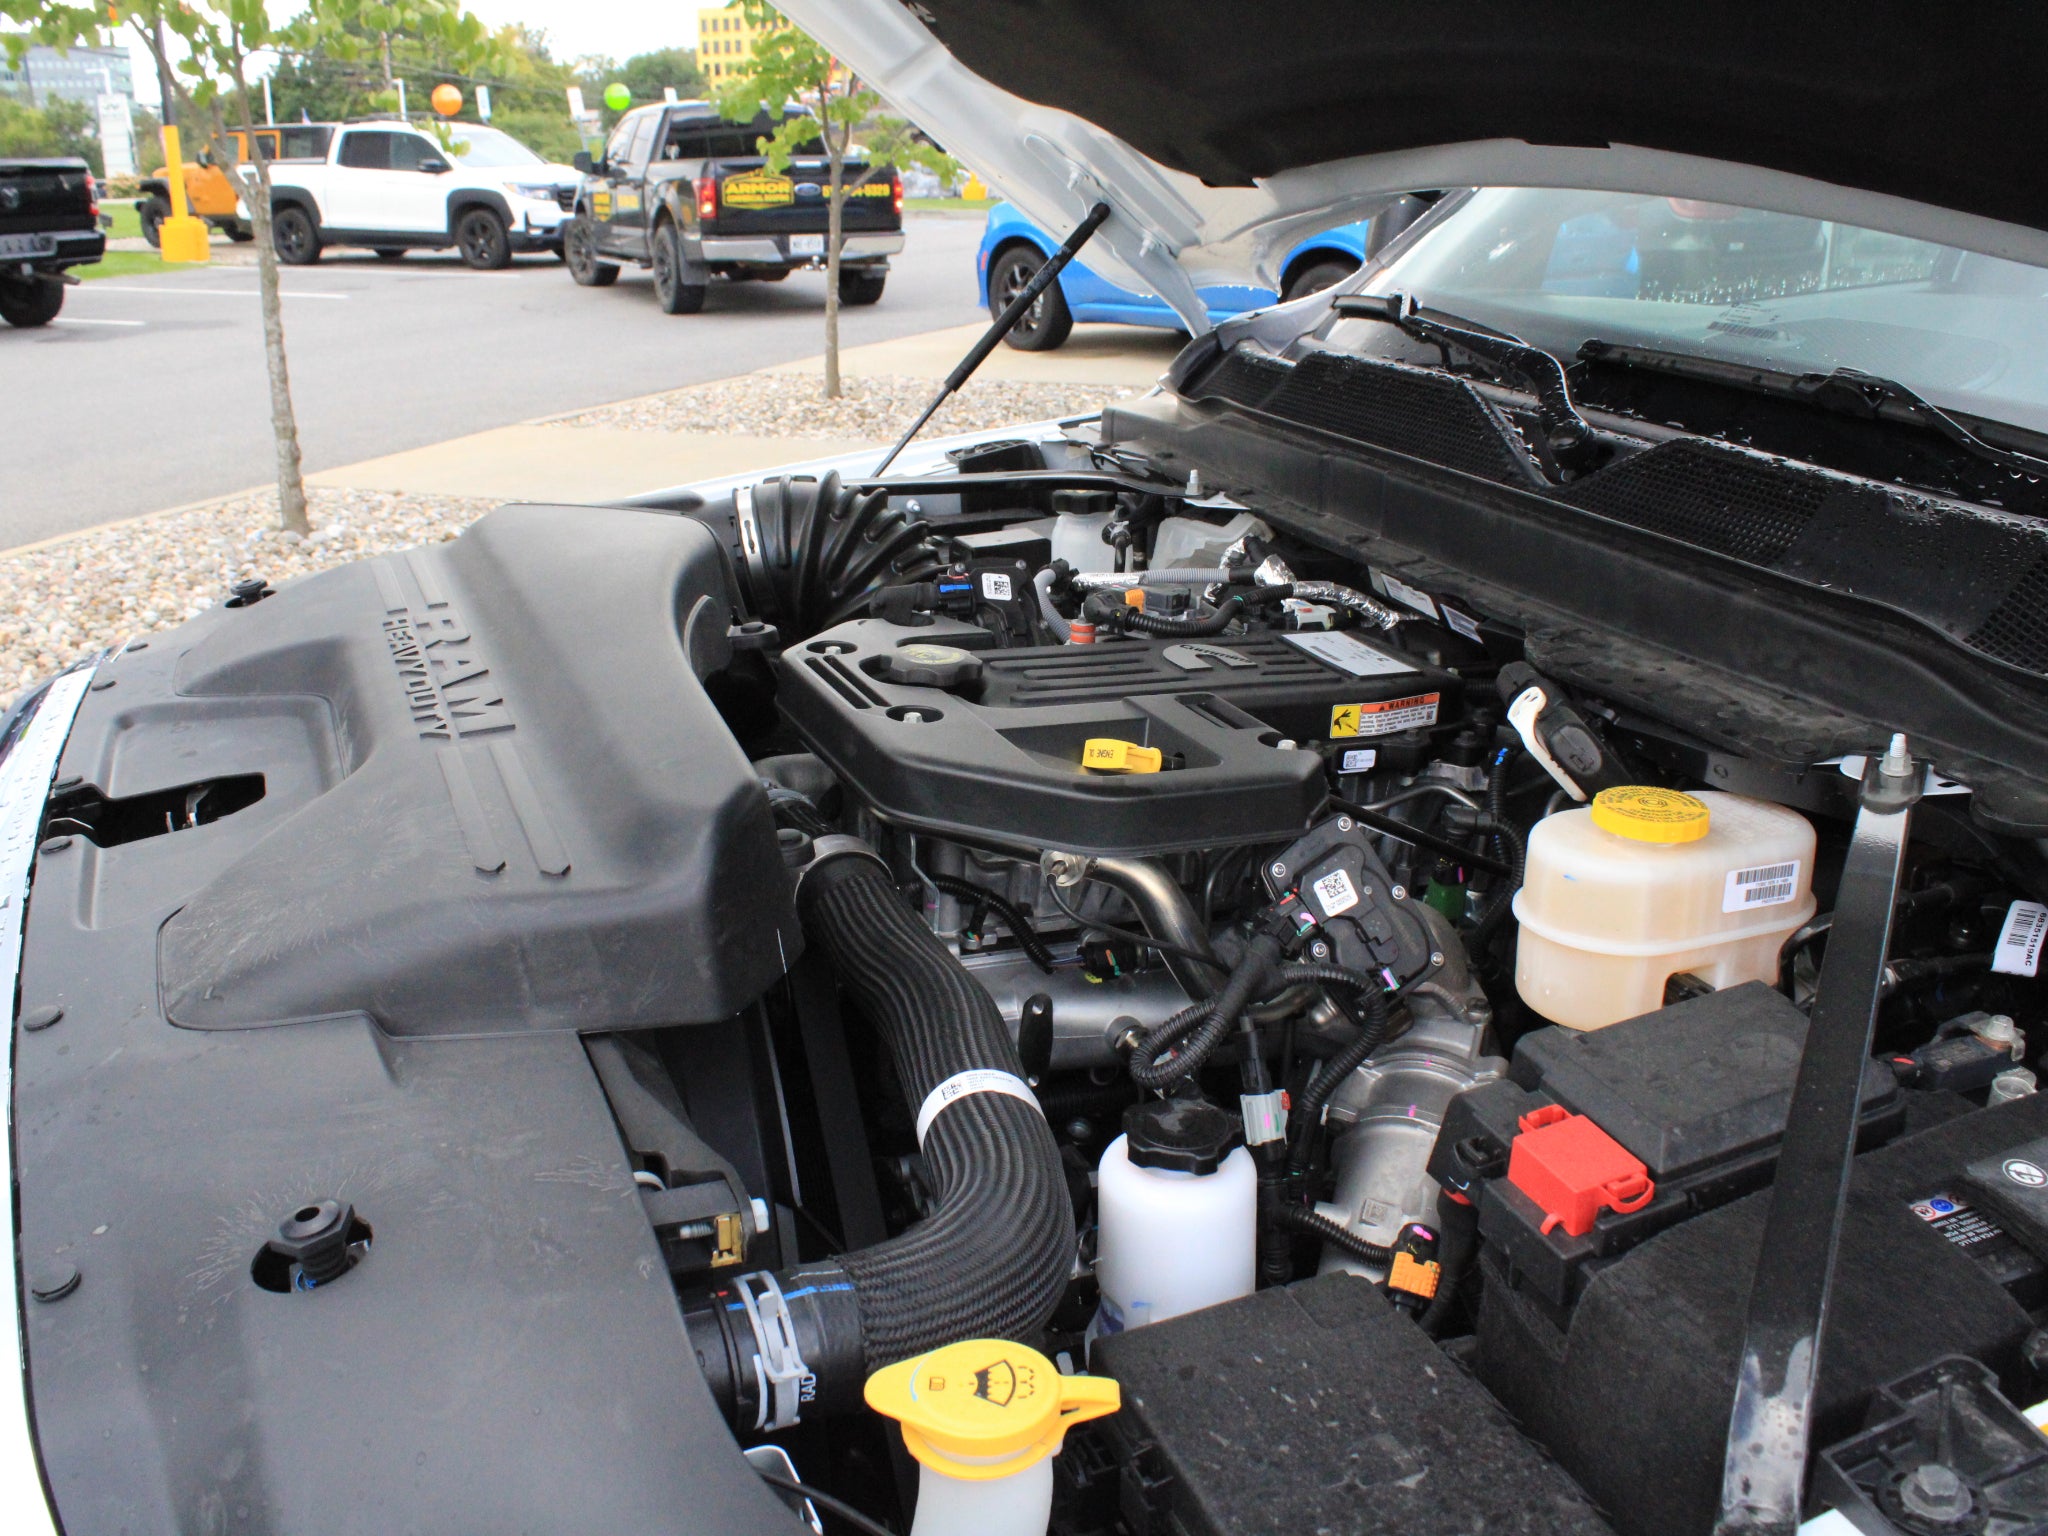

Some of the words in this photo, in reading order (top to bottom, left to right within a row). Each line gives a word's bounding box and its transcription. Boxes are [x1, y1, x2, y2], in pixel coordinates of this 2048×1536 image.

[725, 182, 790, 194] ARMOR
[382, 613, 428, 677] HEAVY
[413, 608, 517, 739] RAM
[403, 675, 452, 740] DUTY
[1389, 696, 1425, 709] WARNING
[2025, 912, 2047, 967] 68351519AC
[801, 1373, 817, 1402] RAD
